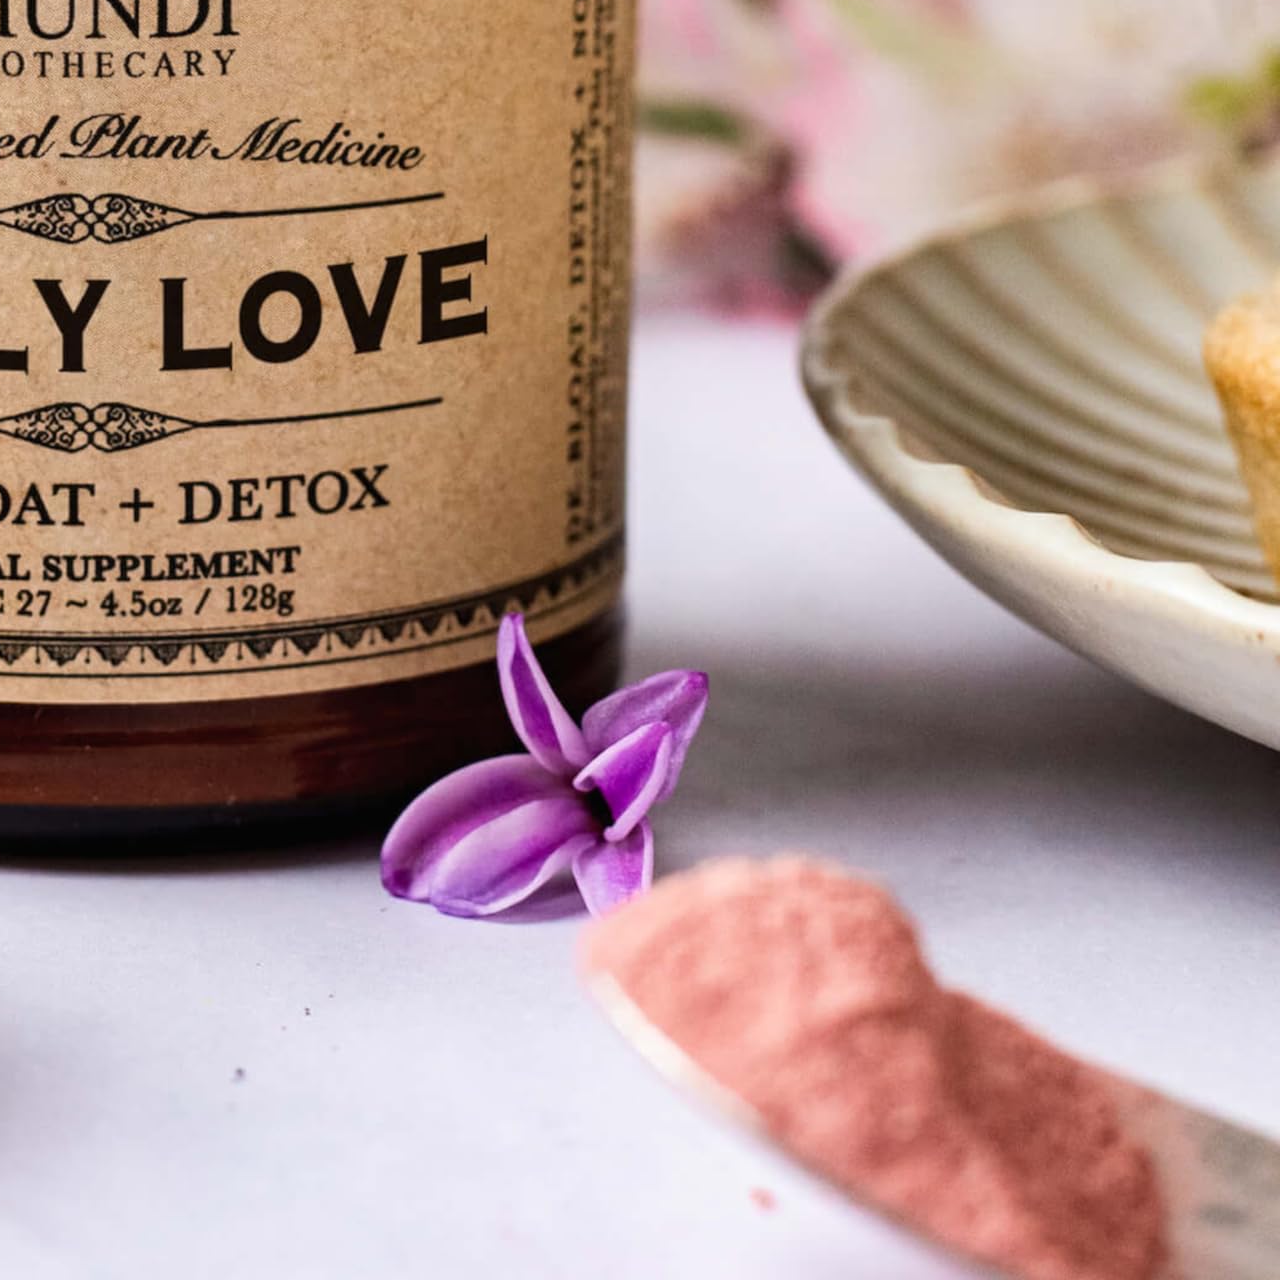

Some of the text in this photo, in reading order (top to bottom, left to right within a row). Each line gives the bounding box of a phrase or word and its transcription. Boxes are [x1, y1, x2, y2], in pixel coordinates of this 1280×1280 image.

[59, 112, 213, 160] Plant
[210, 116, 426, 171] Medicine
[158, 234, 488, 372] LOVE
[119, 488, 155, 523] +
[178, 464, 390, 524] DETOX
[42, 545, 302, 583] SUPPLEMENT
[16, 588, 52, 617] 27
[99, 589, 184, 618] 4.5oz
[194, 586, 212, 616] /
[226, 582, 295, 617] 128g
